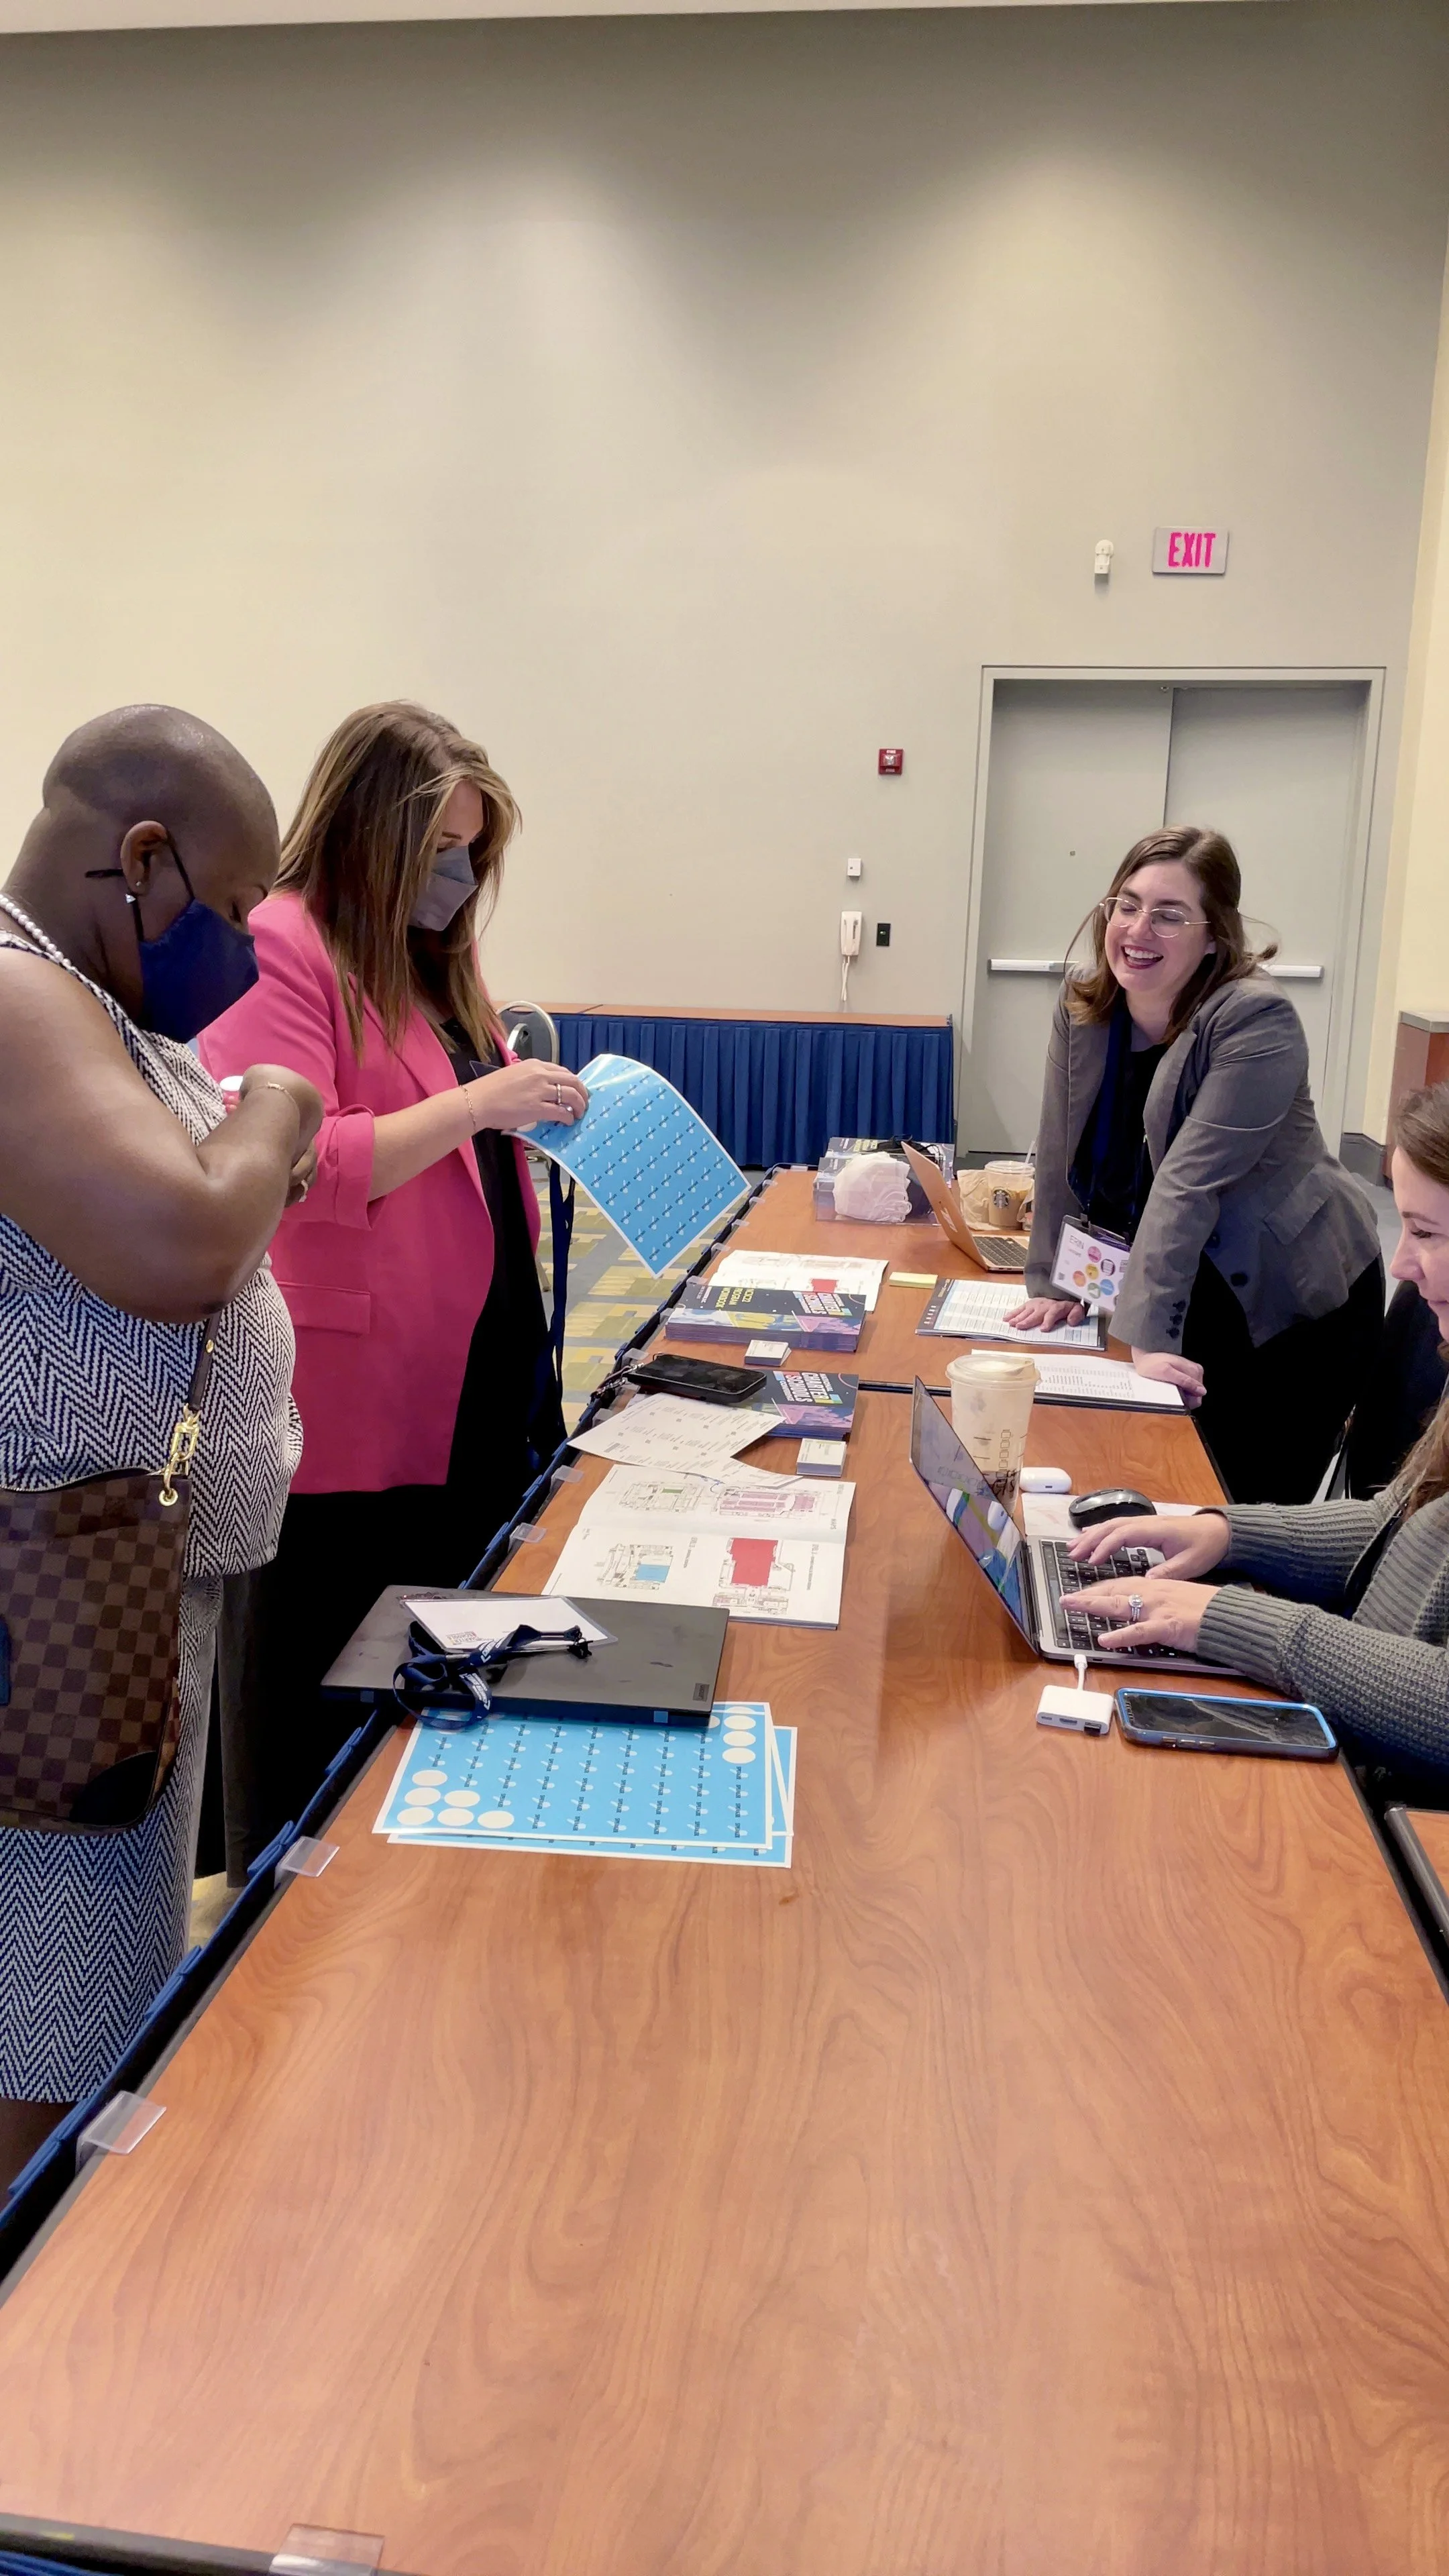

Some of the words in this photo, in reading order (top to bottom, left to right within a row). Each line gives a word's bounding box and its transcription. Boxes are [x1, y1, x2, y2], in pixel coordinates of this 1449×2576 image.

[1168, 532, 1216, 567] EXIT
[803, 1294, 827, 1315] SCHOOLS
[817, 1292, 838, 1313] CHARTER
[785, 1375, 814, 1403] SCHOOLS
[802, 1372, 830, 1400] CHARTER
